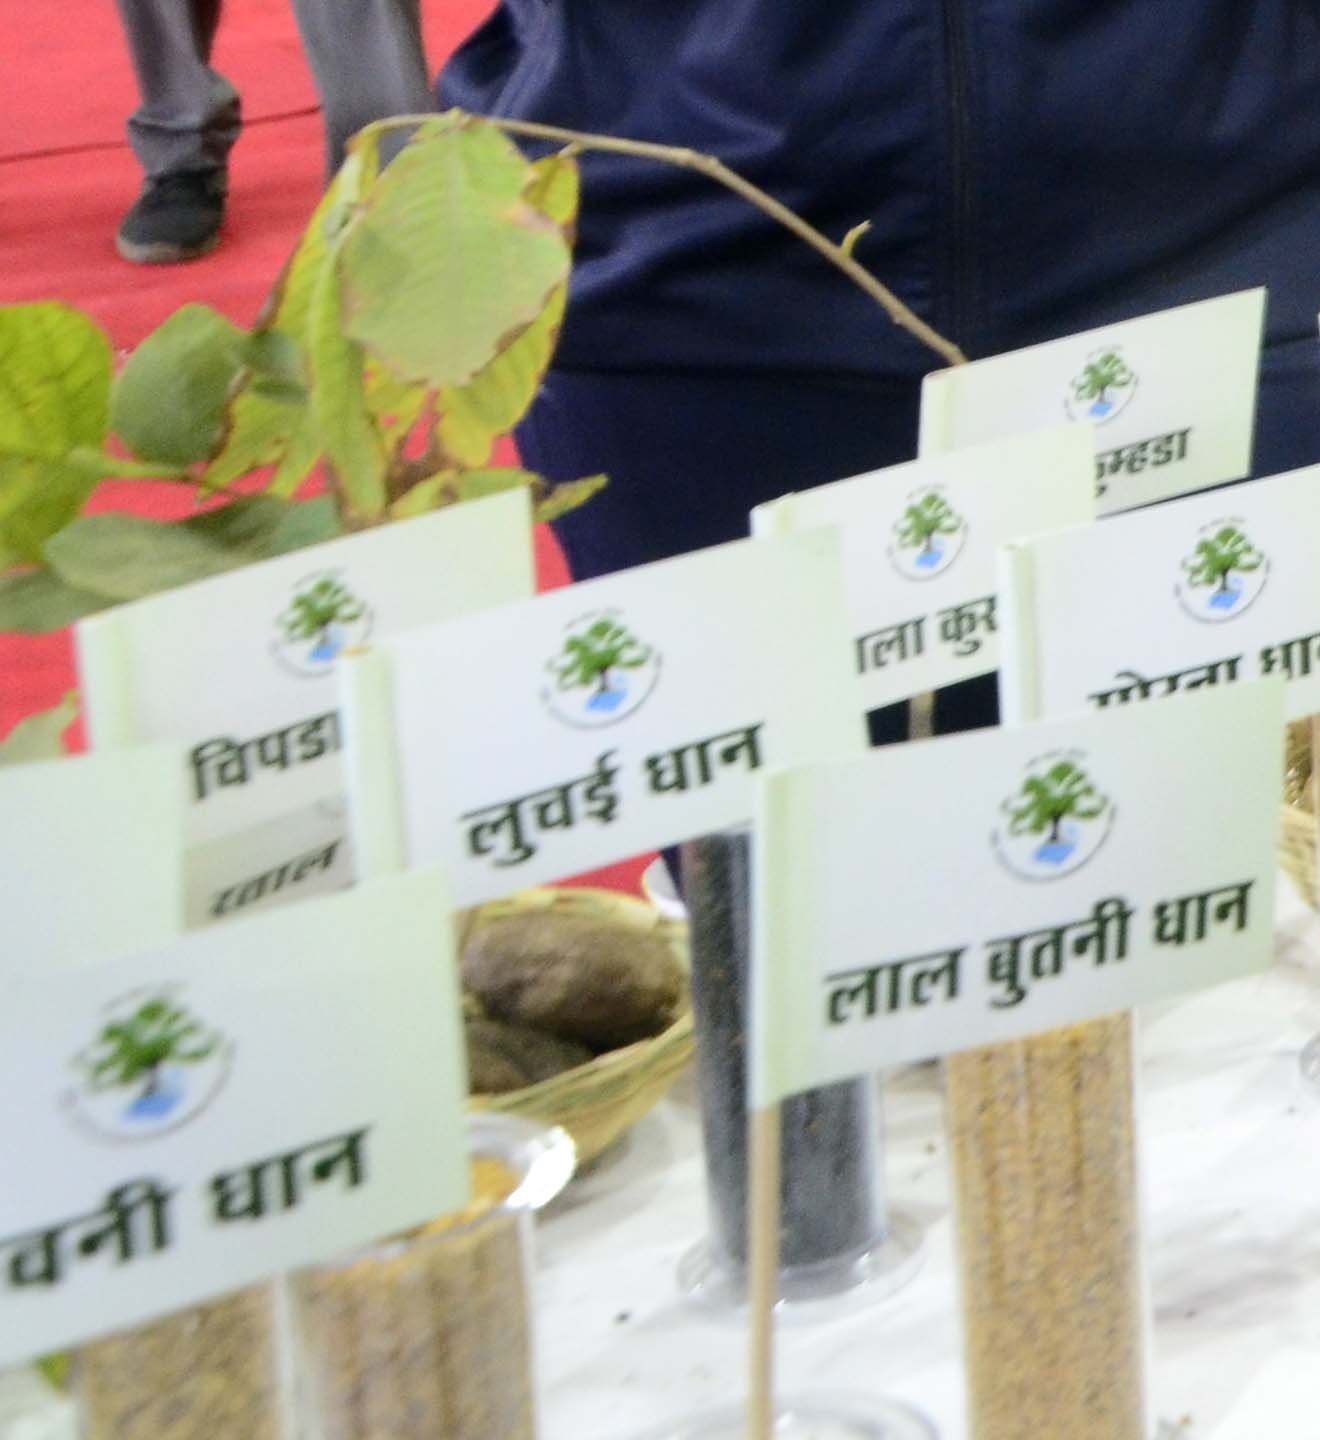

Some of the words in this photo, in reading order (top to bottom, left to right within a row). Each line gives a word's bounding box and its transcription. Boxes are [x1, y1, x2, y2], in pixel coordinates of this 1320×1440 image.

[936, 594, 998, 657] कुर
[459, 747, 620, 868] लुचई
[643, 721, 766, 796] धान
[821, 945, 969, 1026] लाल
[983, 896, 1136, 1009] बुतनी
[1151, 878, 1256, 947] धान
[208, 1123, 374, 1225] धान
